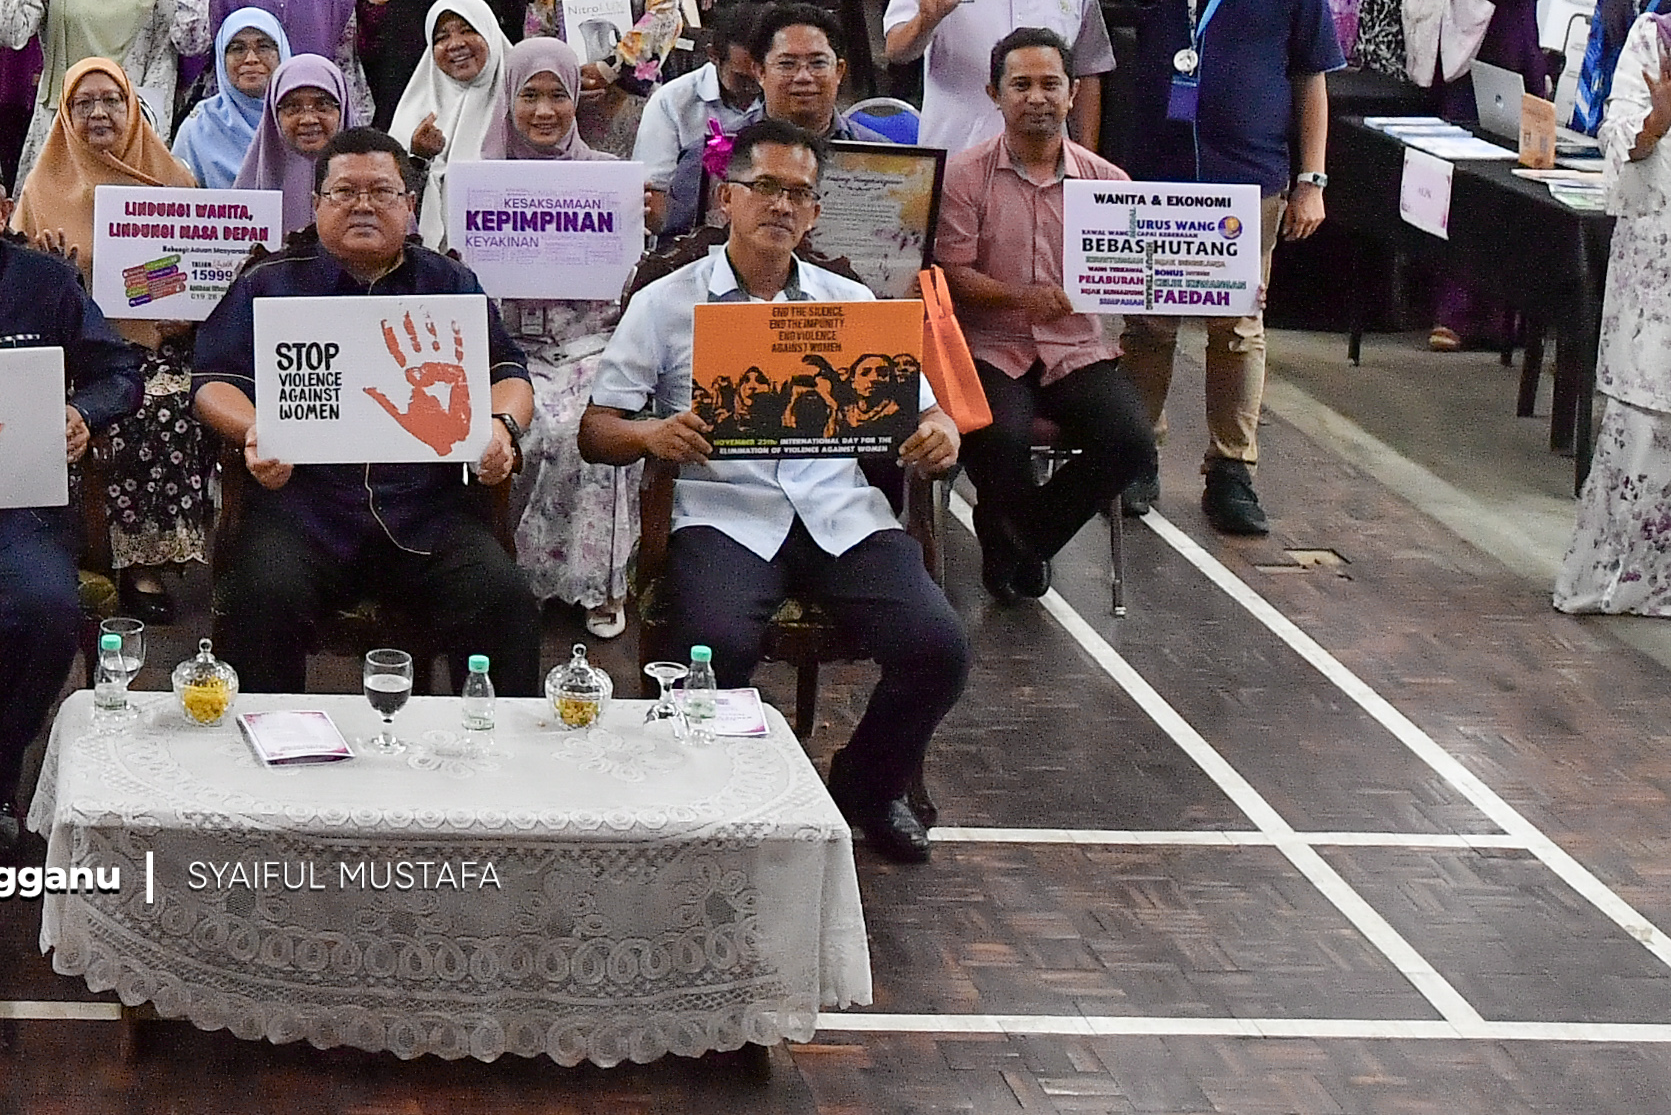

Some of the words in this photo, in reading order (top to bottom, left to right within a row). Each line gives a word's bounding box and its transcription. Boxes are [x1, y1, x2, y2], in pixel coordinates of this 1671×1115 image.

[504, 198, 601, 209] KESAKSAMAAN
[1093, 193, 1147, 206] WANITA
[1151, 195, 1162, 206] &
[1167, 195, 1232, 208] EKONOMI
[124, 201, 191, 218] LINDUNGI
[195, 204, 254, 221] WANITA,
[465, 210, 614, 233] KEPIMPINAN
[1136, 220, 1171, 230] URUS
[1175, 221, 1215, 232] WANG
[109, 223, 175, 239] LINDUNGI
[179, 226, 218, 241] MASA
[223, 227, 269, 242] DEPAN
[465, 236, 539, 248] KEYAKINAN
[1082, 238, 1145, 254] BEBAS
[1154, 240, 1238, 256] HUTANG
[191, 270, 233, 281] 15999
[1078, 275, 1144, 285] PELABURAN
[1154, 290, 1230, 306] FAEDAH
[772, 307, 789, 317] END
[791, 306, 806, 317] THE
[809, 306, 844, 317] SILENCE
[769, 319, 786, 329] END
[788, 319, 803, 329] THE
[803, 317, 845, 328] IMPUNITY
[779, 331, 795, 341] END
[797, 330, 837, 341] VIOLENCE
[771, 342, 808, 353] AGAINST
[809, 342, 842, 353] WOMEN
[275, 342, 340, 372] STOP
[278, 371, 342, 387] VIOLENCE
[279, 387, 342, 403] AGAINST
[279, 403, 340, 420] WOMEN
[780, 437, 839, 445] INTERNATIONAL
[771, 446, 781, 454] OF
